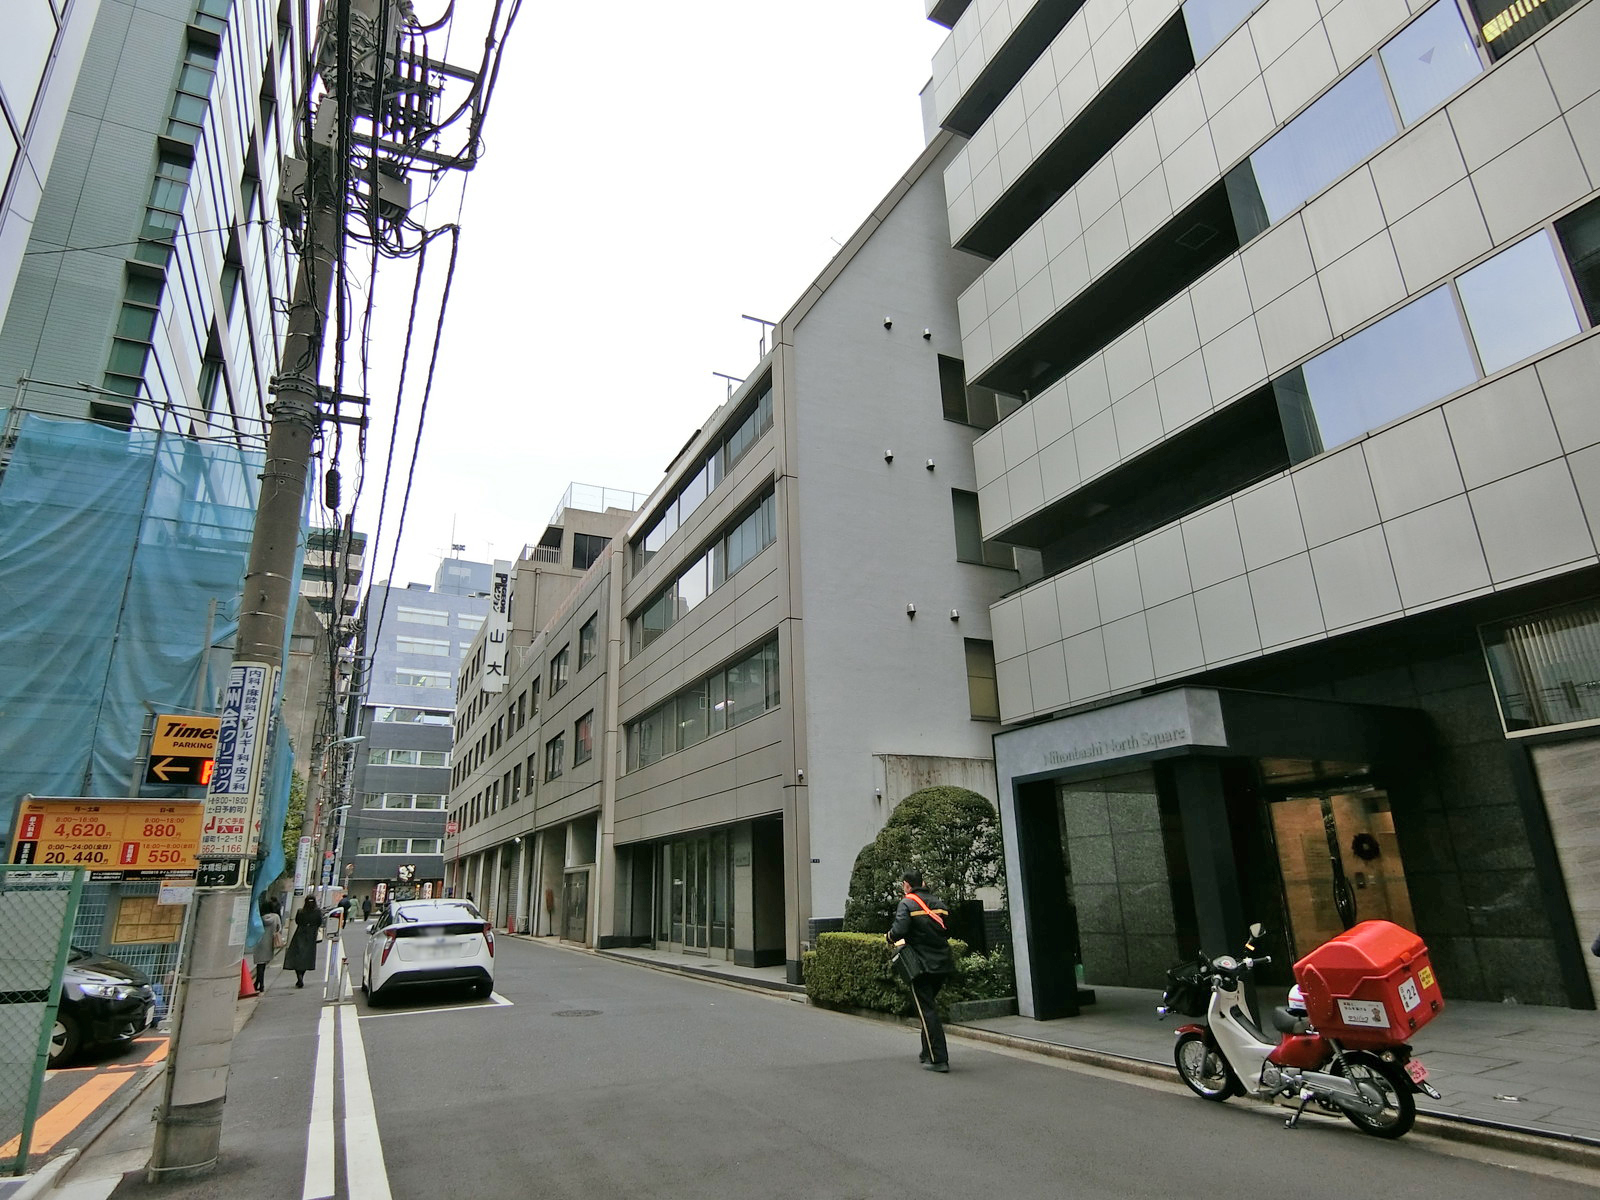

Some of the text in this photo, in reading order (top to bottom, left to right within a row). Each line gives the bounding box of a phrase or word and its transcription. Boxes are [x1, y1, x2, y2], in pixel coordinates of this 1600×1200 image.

[164, 722, 218, 739] Times
[173, 741, 213, 749] PARKING
[1043, 728, 1186, 766] Nihonbashi North Square
[203, 874, 225, 883] 1-2
[1406, 985, 1417, 1000] 22
